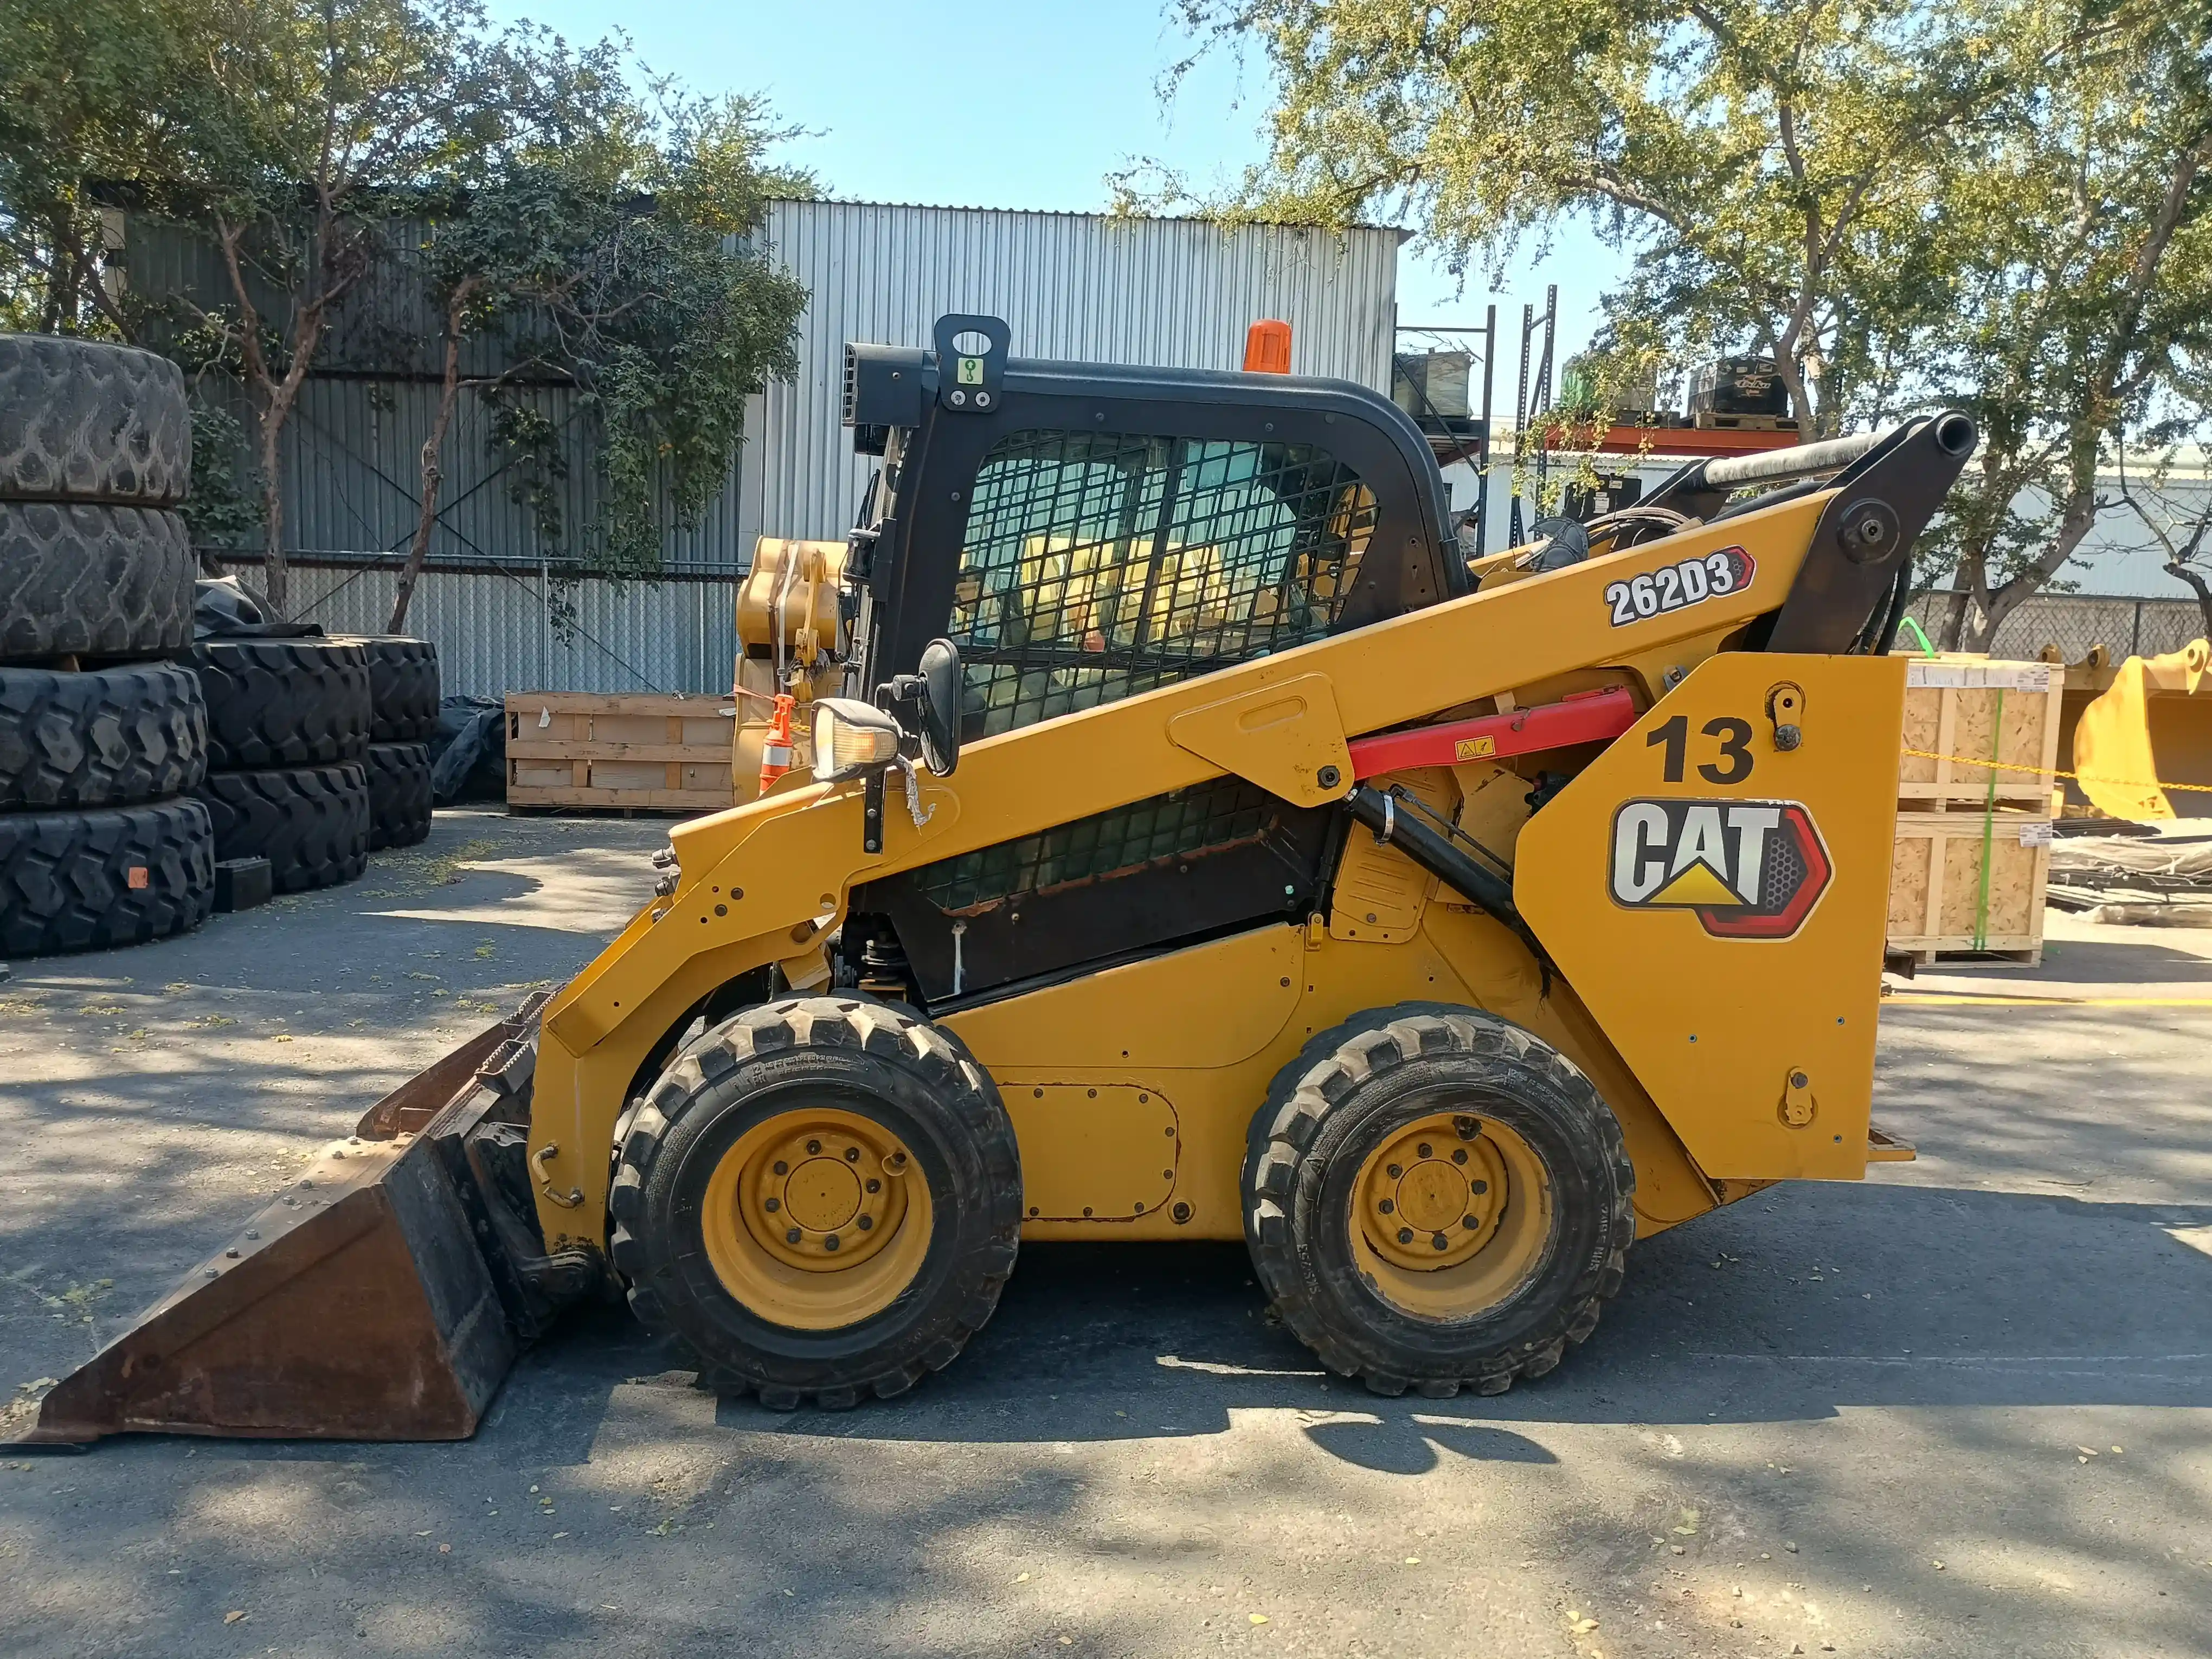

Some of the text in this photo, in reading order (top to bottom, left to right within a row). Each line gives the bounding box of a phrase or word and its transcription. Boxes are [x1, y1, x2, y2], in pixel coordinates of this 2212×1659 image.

[1606, 553, 1735, 625] 262D3
[1646, 716, 1754, 785] 13
[1613, 803, 1782, 905] CAT
